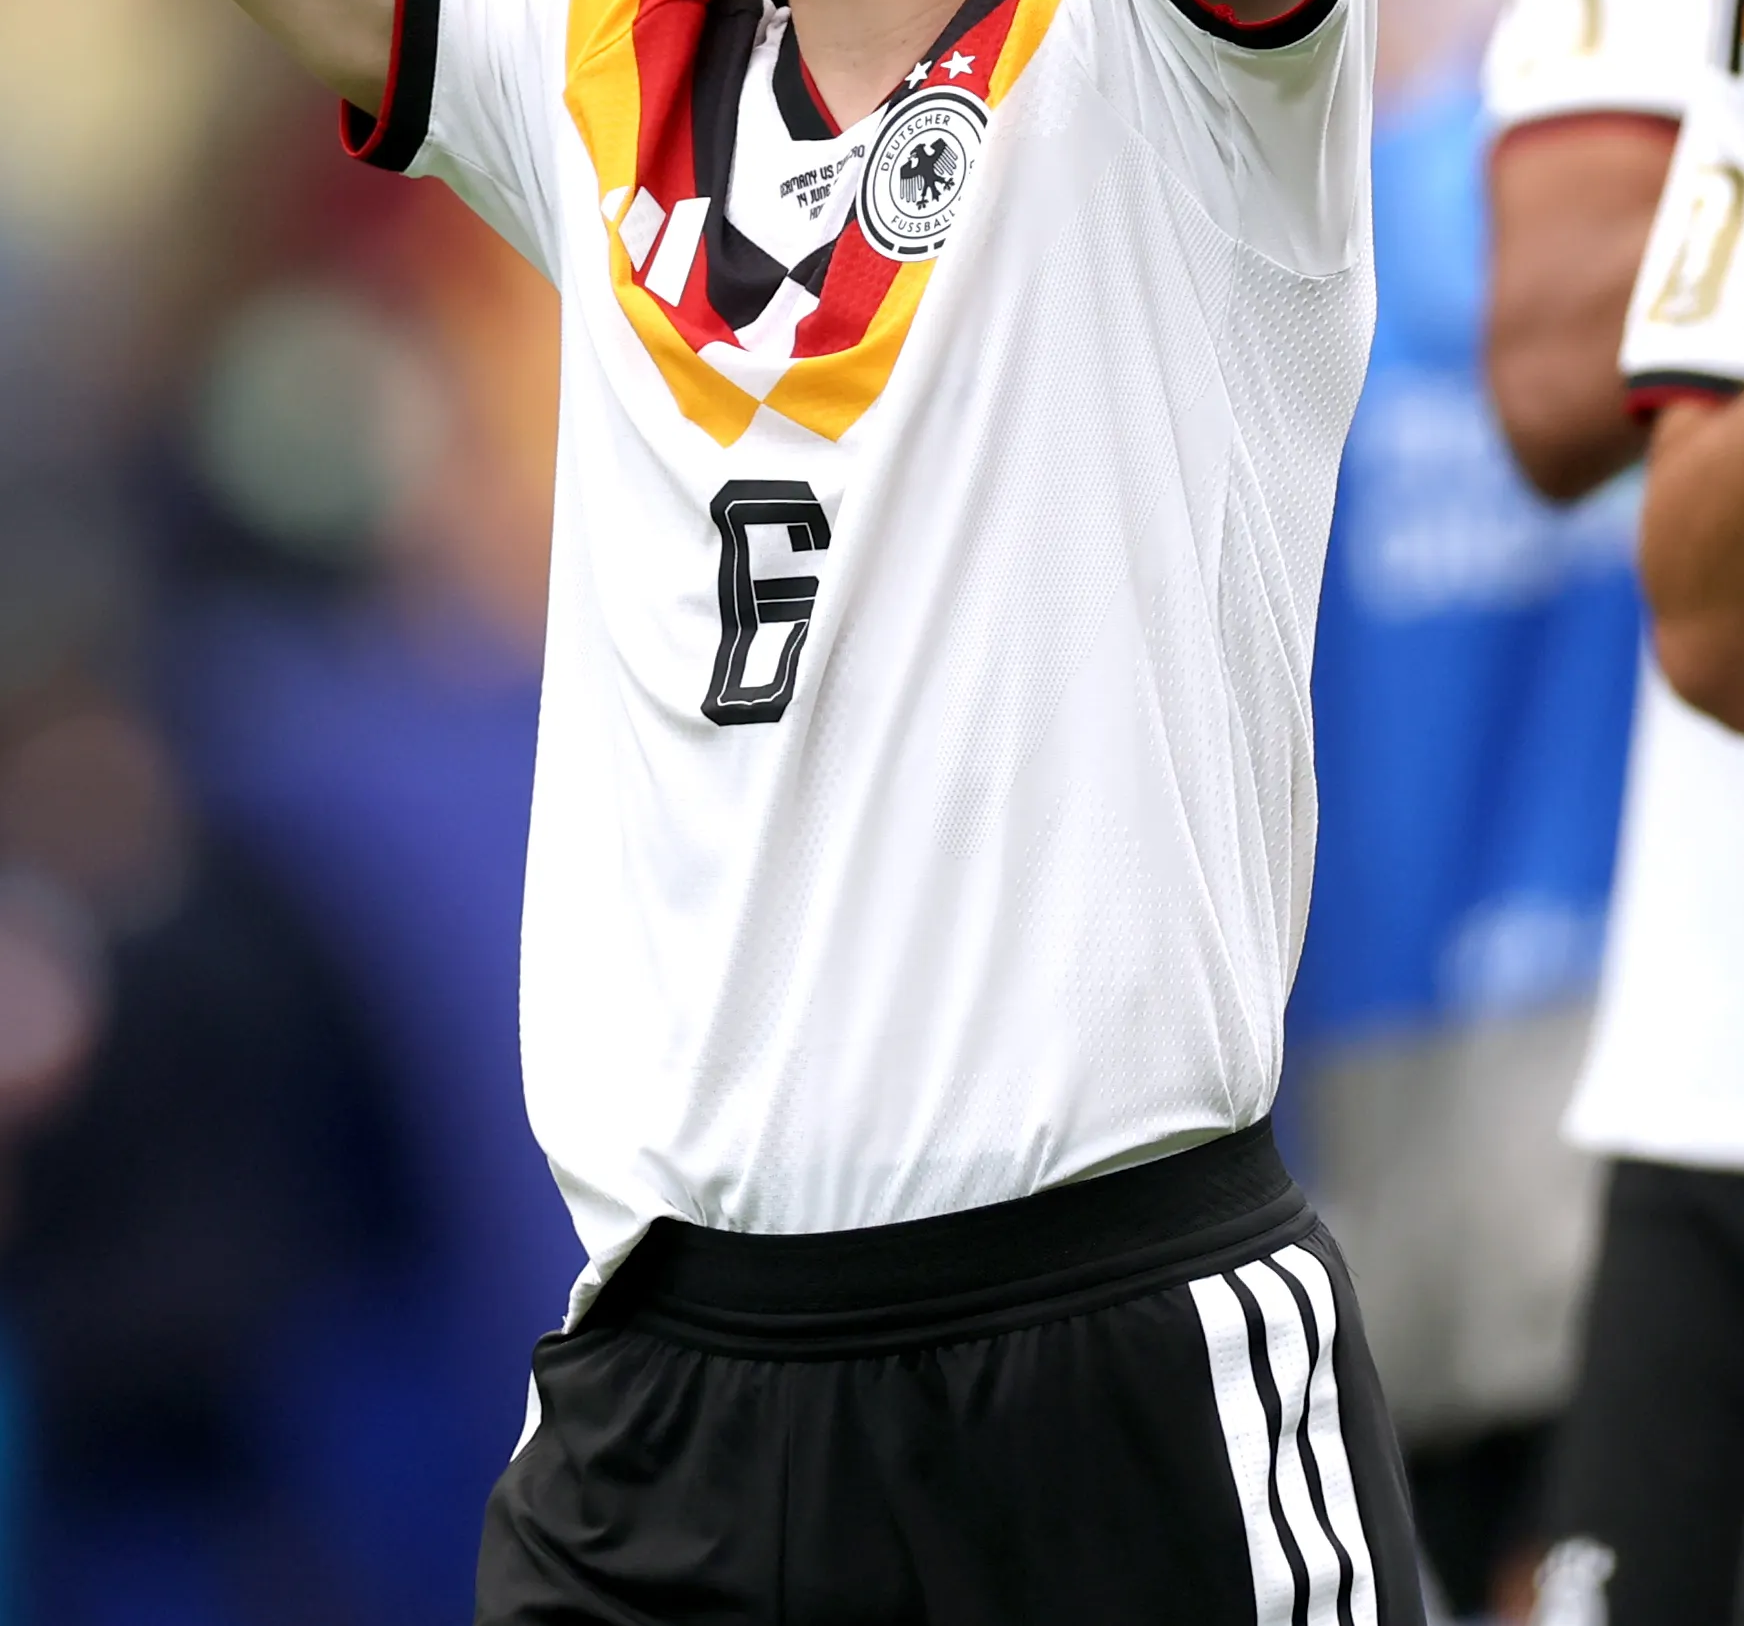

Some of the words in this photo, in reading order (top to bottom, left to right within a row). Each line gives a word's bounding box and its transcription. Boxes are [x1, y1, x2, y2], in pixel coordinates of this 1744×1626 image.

[880, 113, 951, 172] DEUTSCHER
[796, 191, 809, 209] 14
[810, 183, 831, 204] JUNE
[891, 209, 956, 233] FUSSBALL
[700, 480, 832, 726] 6
